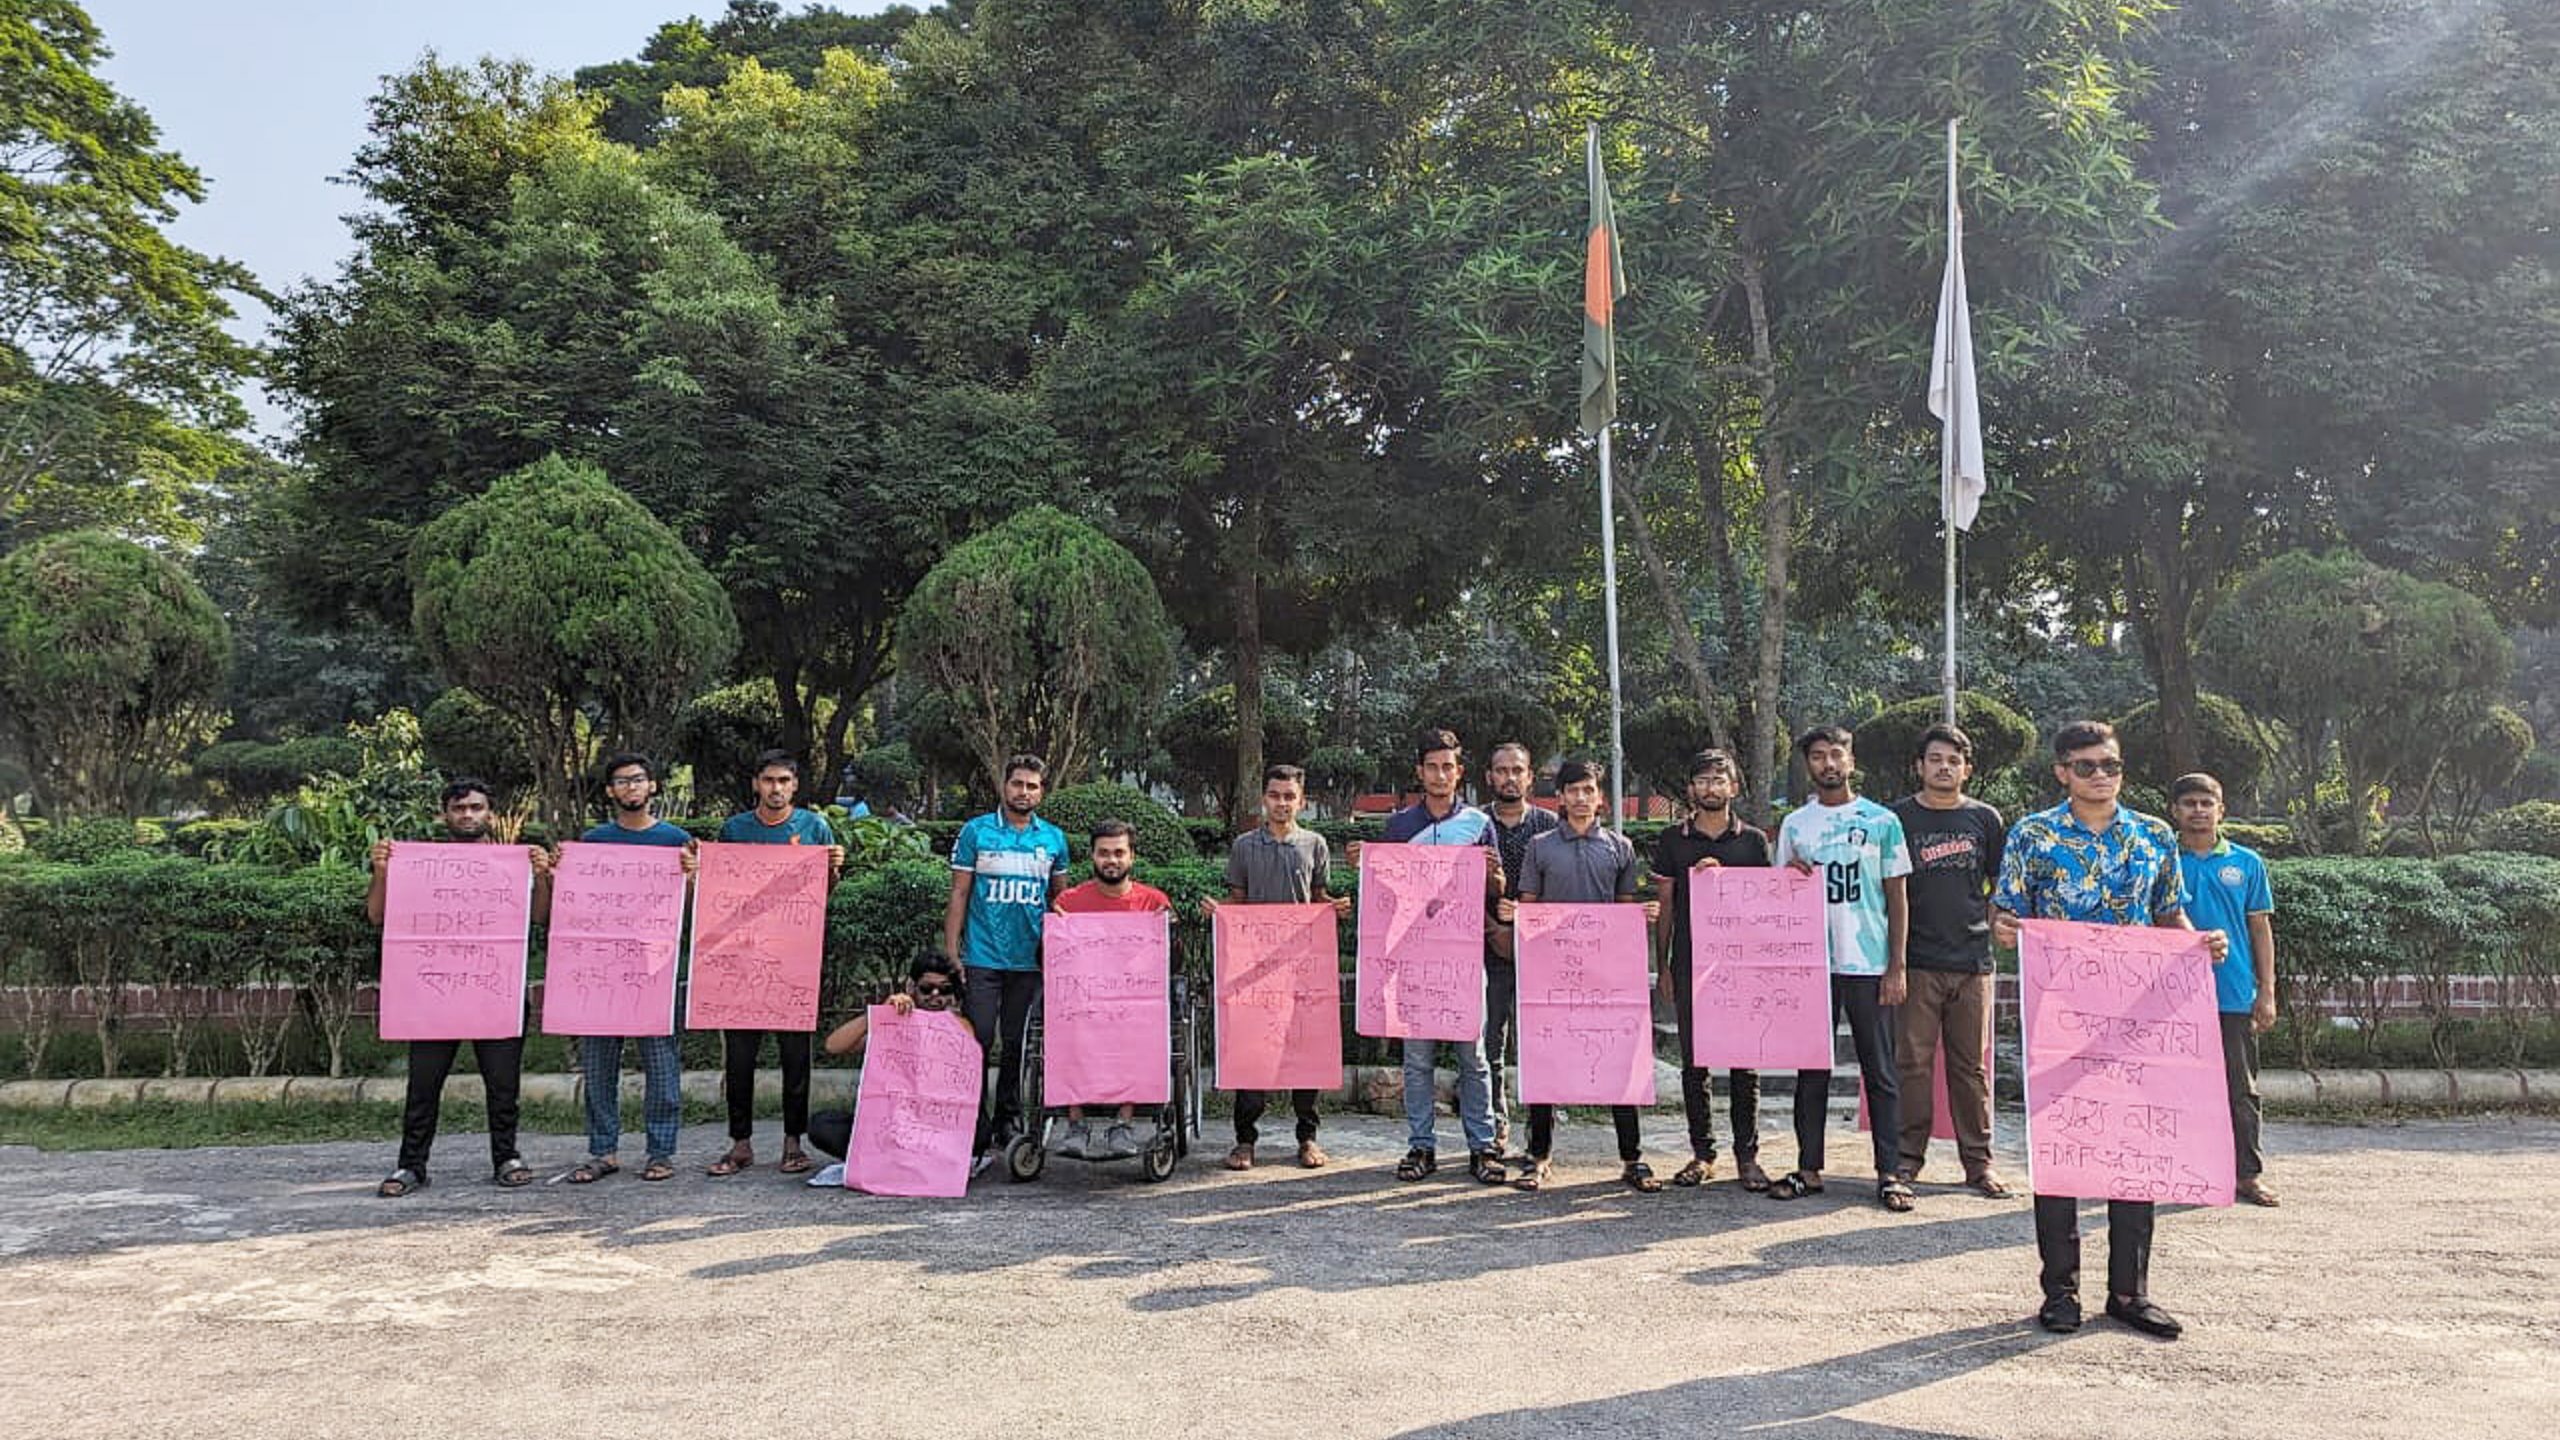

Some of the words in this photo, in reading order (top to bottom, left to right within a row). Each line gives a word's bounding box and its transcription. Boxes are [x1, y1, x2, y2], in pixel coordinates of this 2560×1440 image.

[1718, 877, 1809, 903] FDRF
[412, 910, 497, 934] FDRF
[2038, 1142, 2096, 1168] FDRF
